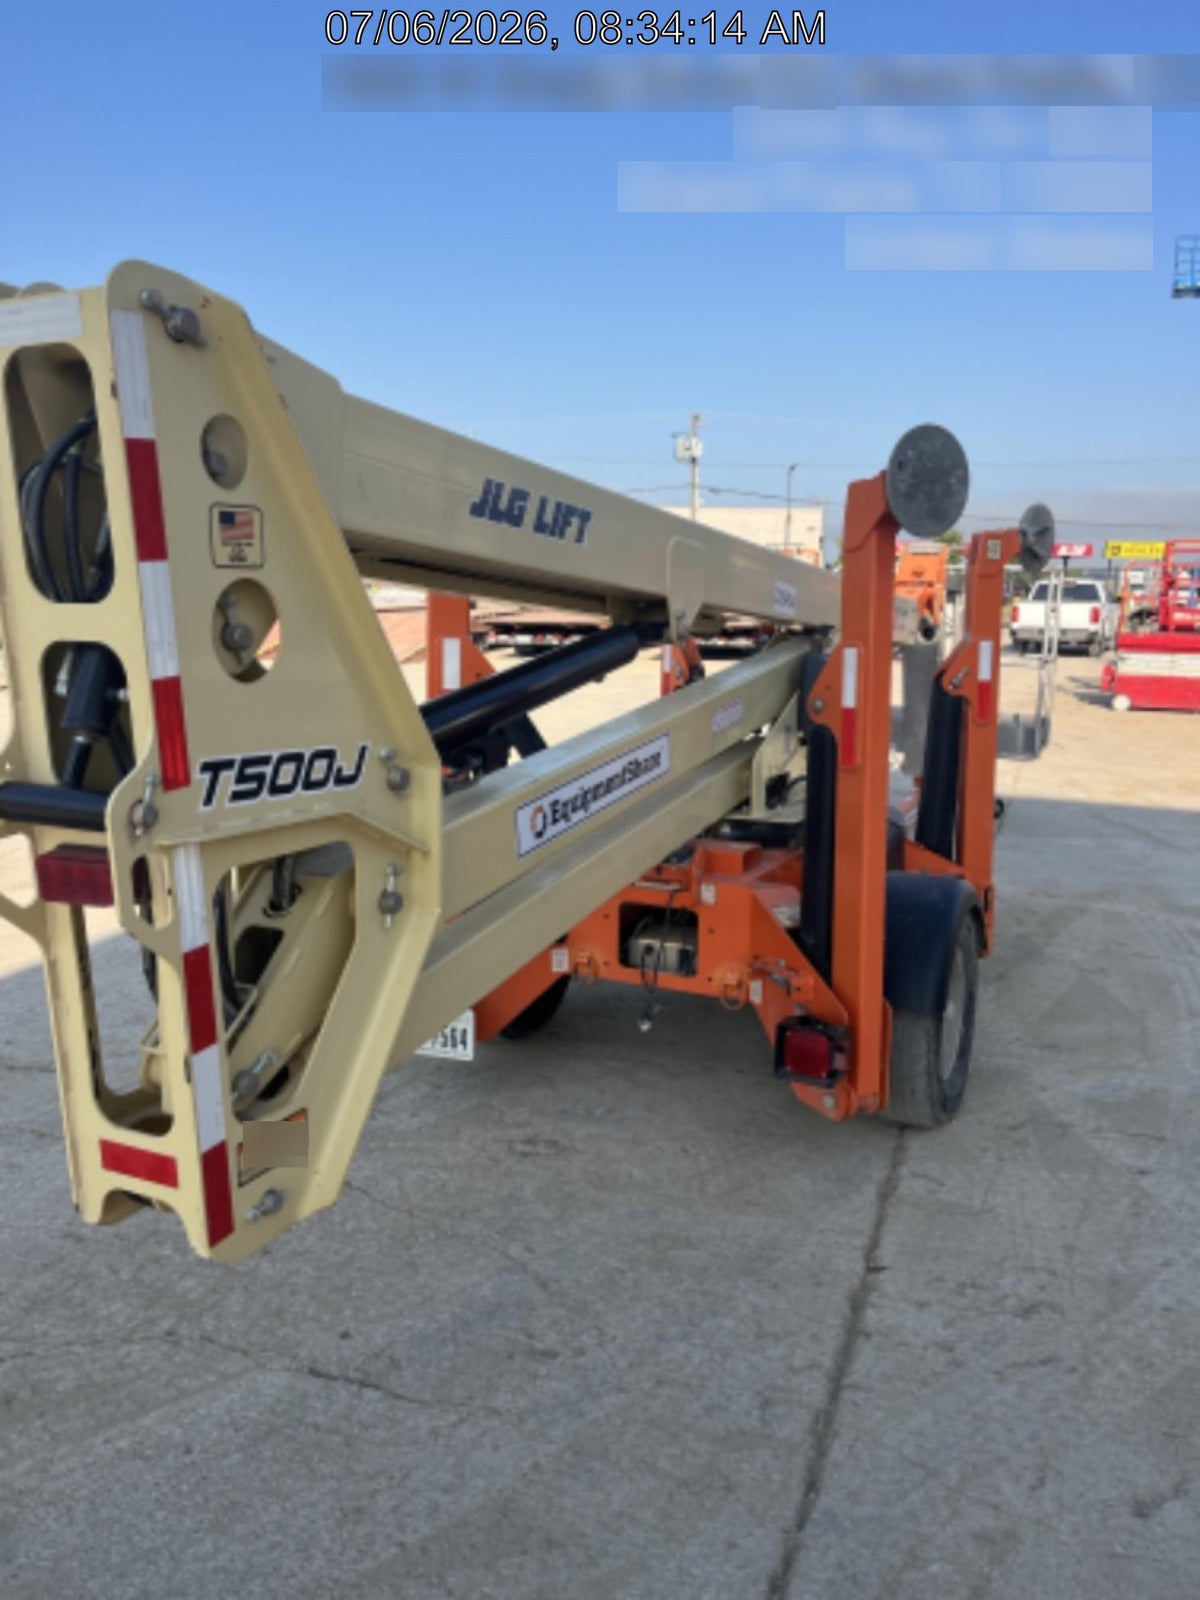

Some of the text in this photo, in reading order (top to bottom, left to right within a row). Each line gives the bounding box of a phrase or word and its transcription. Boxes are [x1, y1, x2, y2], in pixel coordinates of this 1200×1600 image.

[469, 478, 593, 544] JLG LIFT
[199, 743, 369, 810] T500J
[431, 1026, 468, 1052] 564
